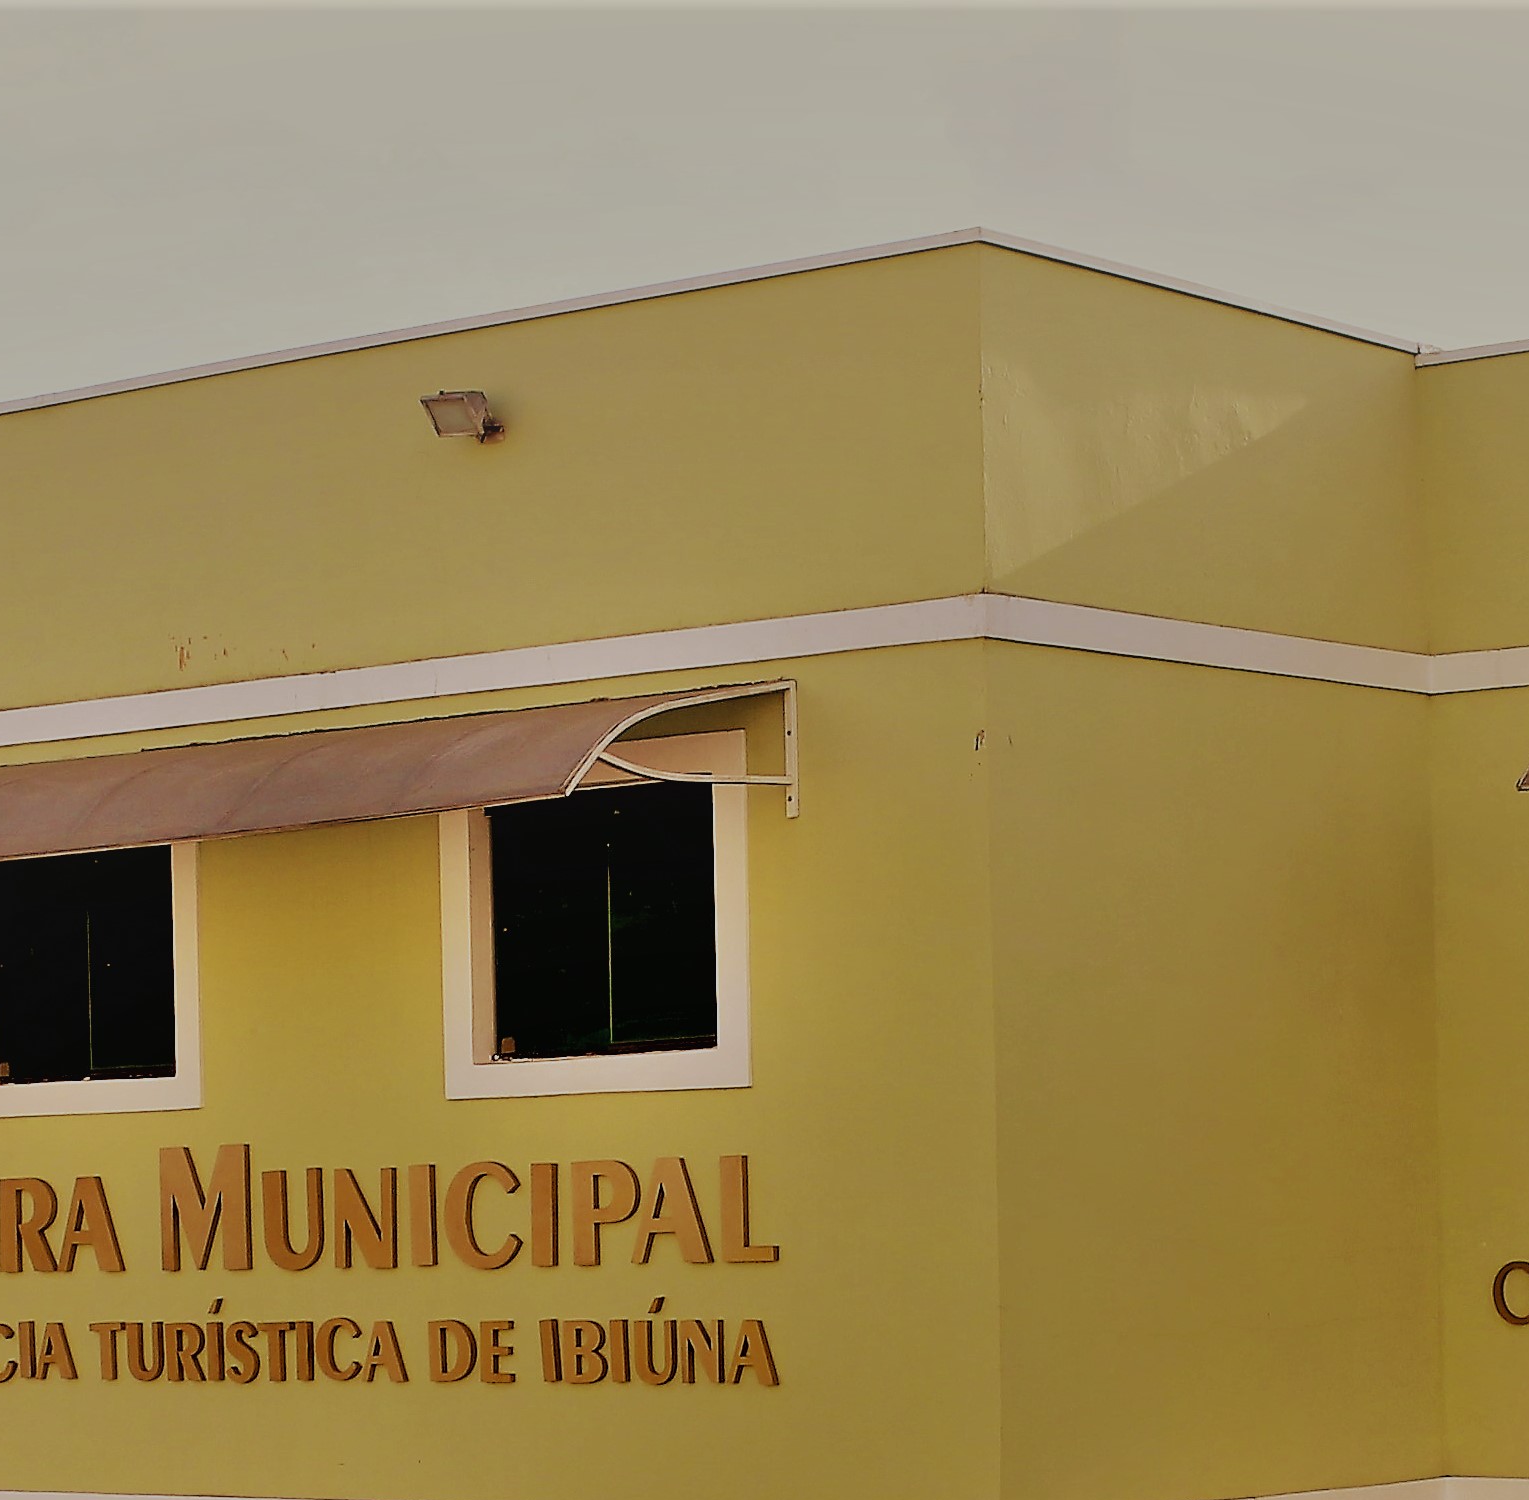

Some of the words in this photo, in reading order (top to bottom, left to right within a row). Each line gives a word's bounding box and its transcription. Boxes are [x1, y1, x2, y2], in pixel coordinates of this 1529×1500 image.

[159, 1143, 780, 1272] MUNICIPAL
[89, 1297, 409, 1384] TURÍSTICA
[428, 1319, 516, 1384] DE
[539, 1297, 780, 1387] IBIÚNA
